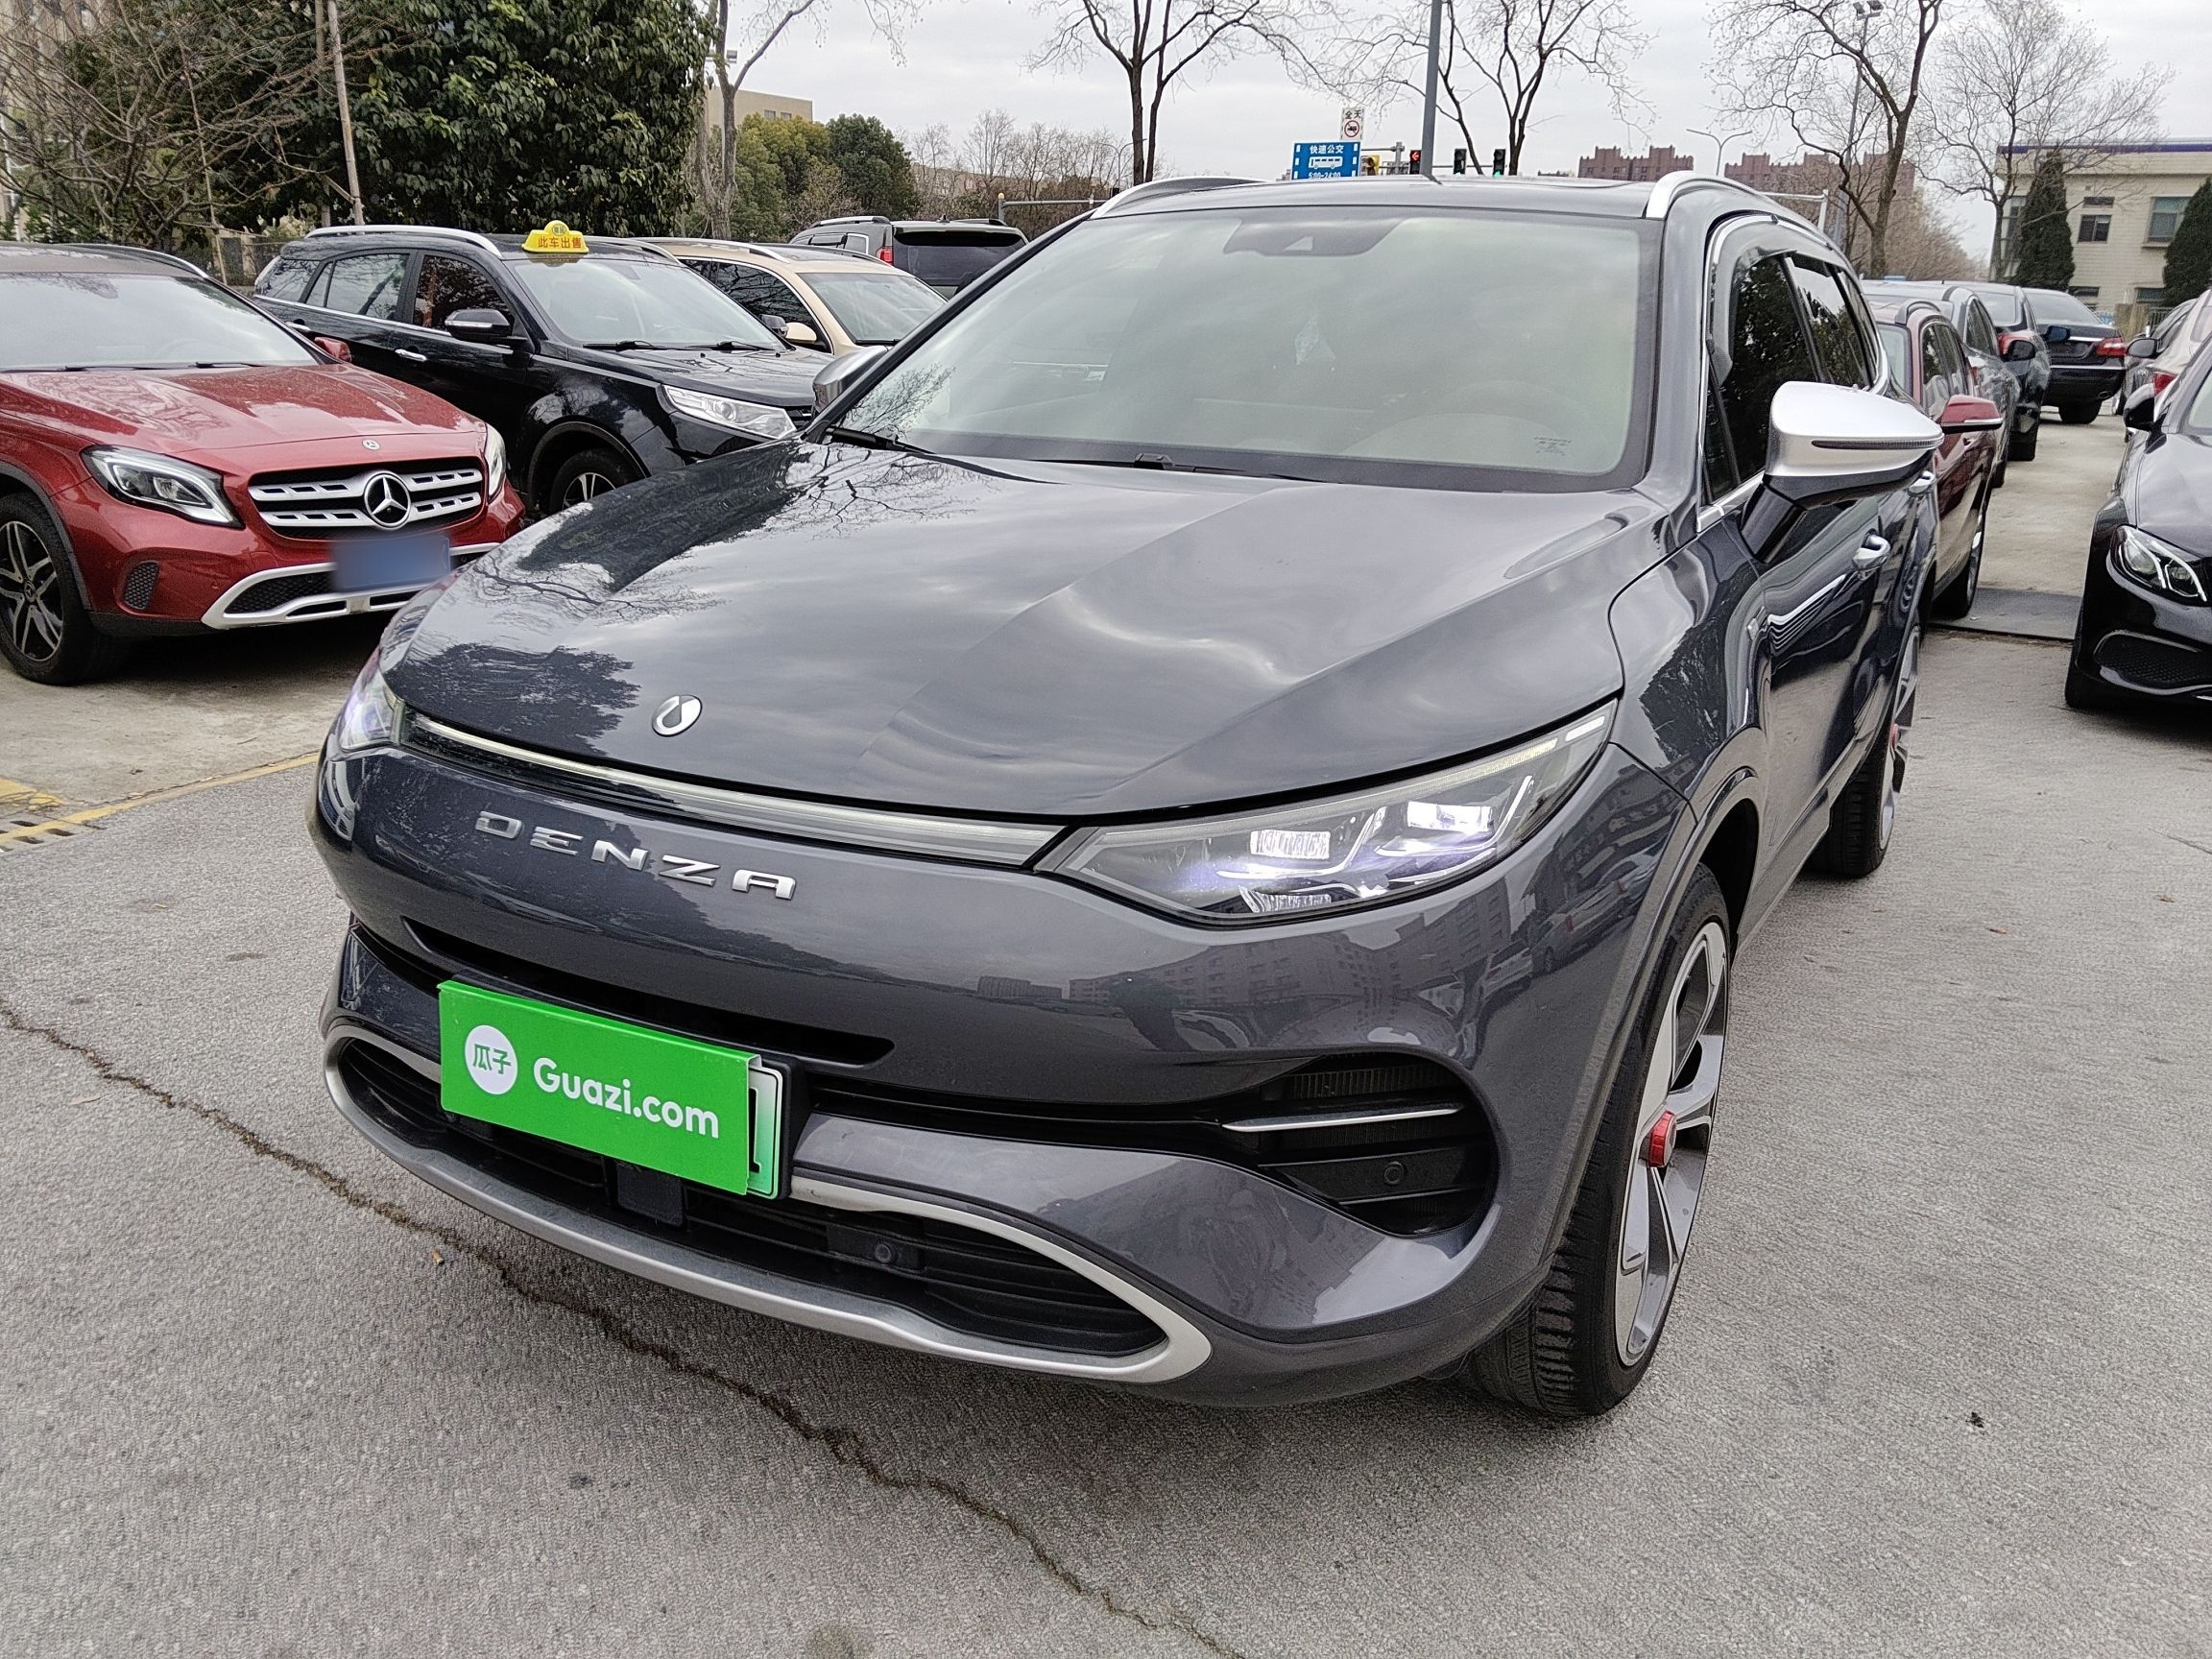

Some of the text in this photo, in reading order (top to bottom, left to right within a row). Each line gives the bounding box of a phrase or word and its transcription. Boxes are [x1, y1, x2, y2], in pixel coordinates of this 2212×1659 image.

[1345, 109, 1361, 119] 全天
[1310, 145, 1344, 154] 快速公交
[538, 236, 581, 248] 此车出售
[475, 810, 797, 901] DENZA
[471, 1043, 512, 1075] 瓜子
[533, 1057, 720, 1140] Guazi.com
